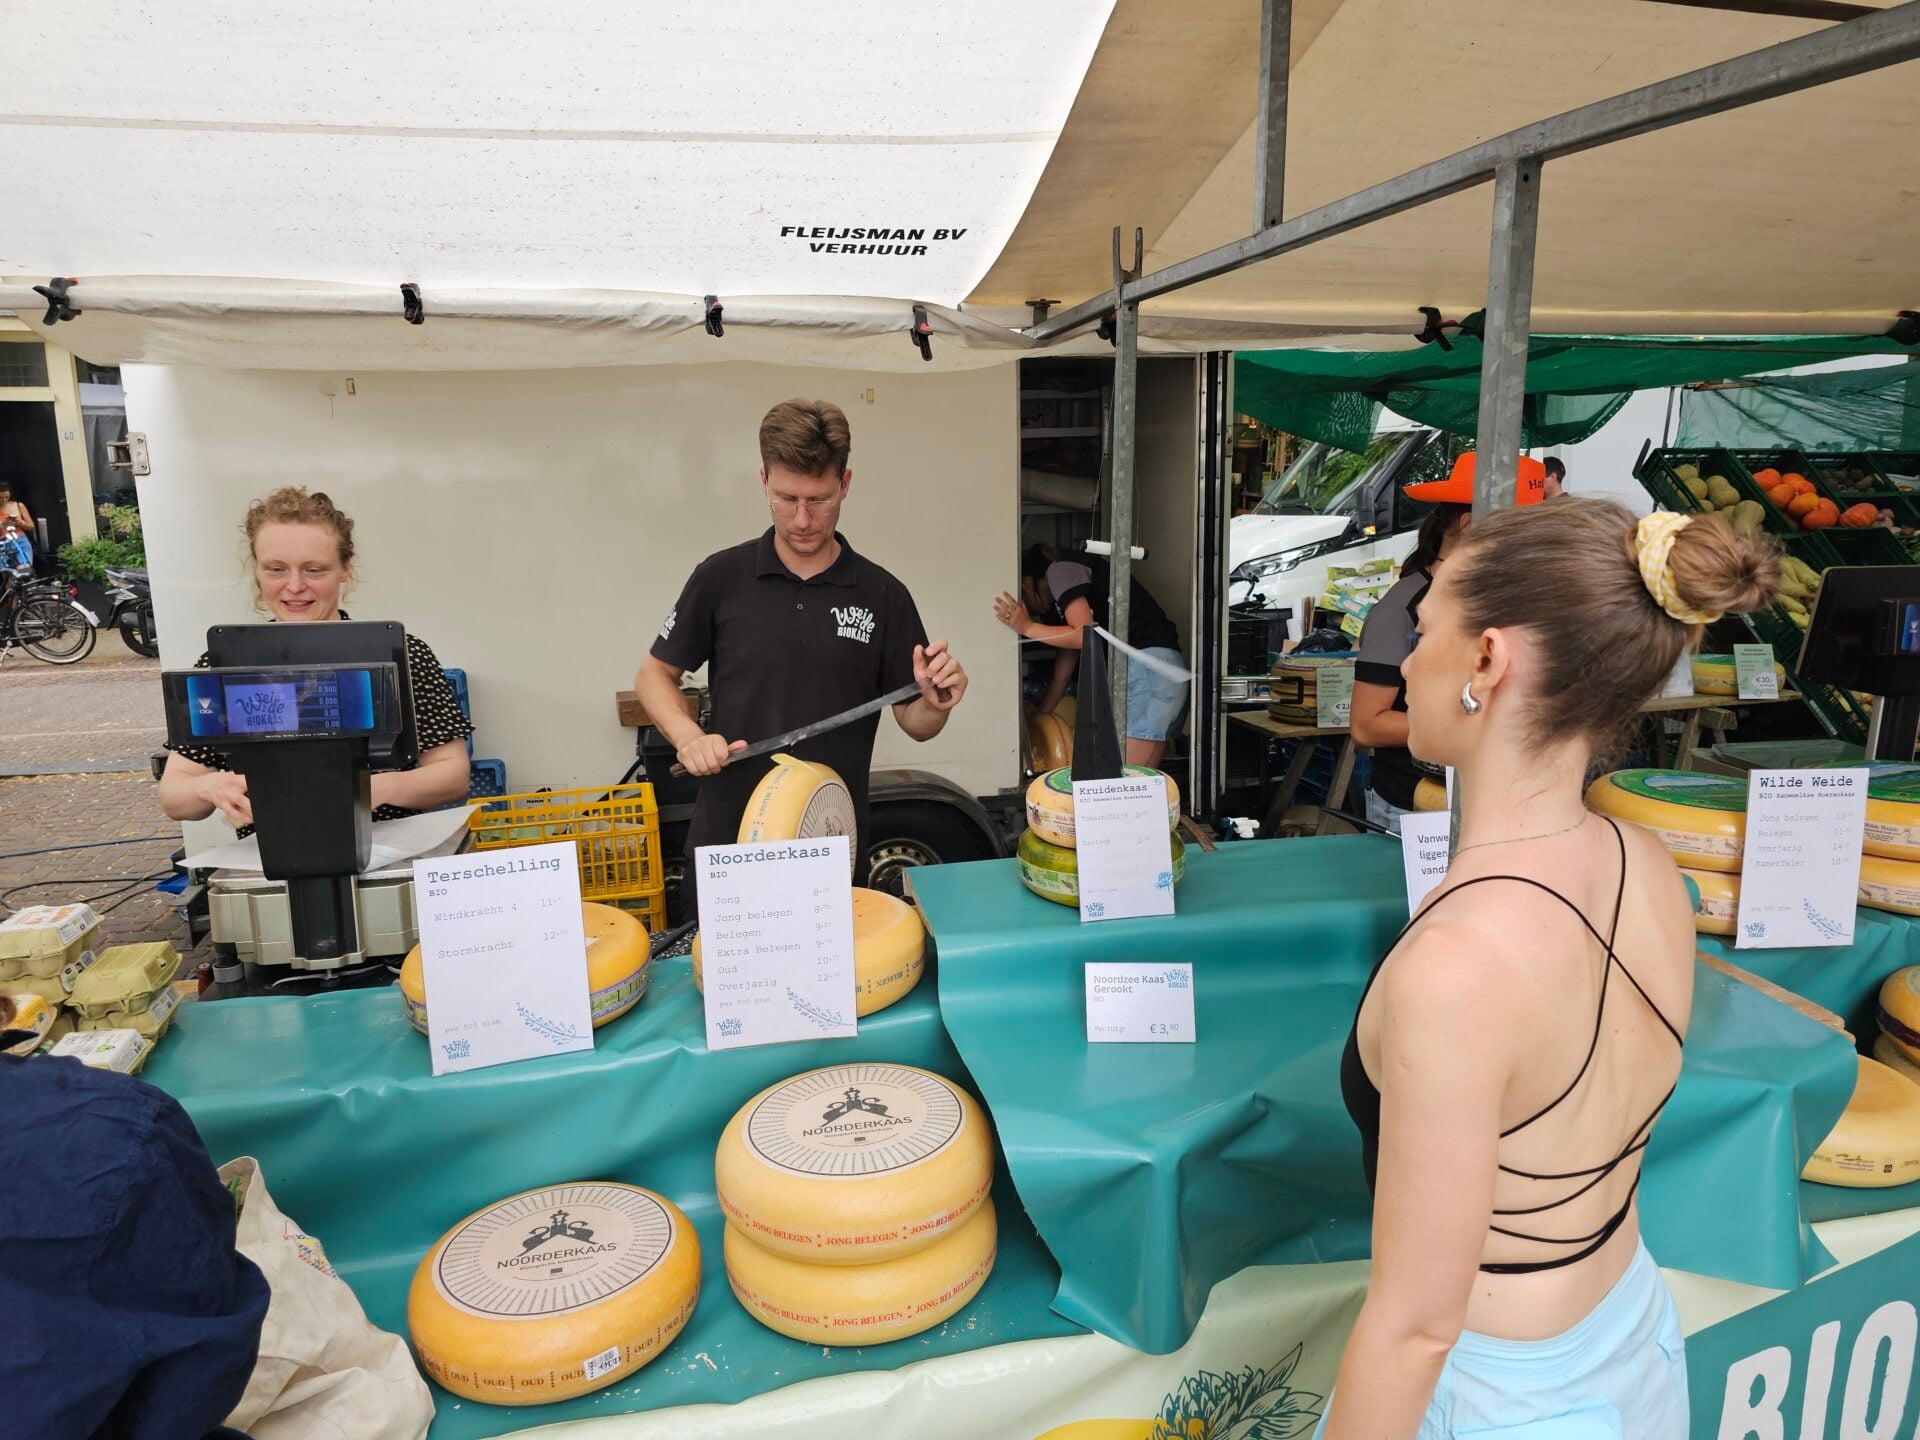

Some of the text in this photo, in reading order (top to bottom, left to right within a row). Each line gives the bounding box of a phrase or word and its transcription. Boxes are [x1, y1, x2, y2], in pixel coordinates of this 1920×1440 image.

[780, 226, 968, 240] FLEIJSMAN BV
[809, 243, 928, 256] VERHUUR
[837, 626, 871, 644] BIOKAAS
[247, 714, 284, 726] BIOKAAS
[1759, 775, 1853, 788] Wilde Weide
[1079, 784, 1148, 796] Kruidenkaas
[1759, 814, 1780, 823] Jong
[1784, 814, 1819, 823] belegen
[1758, 830, 1793, 838] Belegen
[1756, 844, 1802, 853] Overjarig
[709, 847, 831, 866] Noorderkaas
[428, 858, 561, 883] Terschelling
[710, 871, 728, 879] BIO
[429, 888, 448, 897] BIO
[714, 896, 740, 905] Jong
[434, 905, 504, 922] Windkracht
[511, 903, 518, 912] 4
[715, 913, 741, 923] Jong
[747, 908, 793, 920] belegen
[716, 929, 761, 940] Belegen
[438, 940, 514, 959] Stormkracht
[717, 948, 749, 957] Extra
[756, 943, 801, 954] Belegen
[718, 966, 738, 974] Oud
[718, 979, 777, 991] Overjarig
[1093, 975, 1165, 984] Noordzee Kaas
[1094, 985, 1133, 994] Gerookt
[1150, 1023, 1157, 1034] €
[802, 1116, 913, 1137] NOORDERKAAS
[753, 1220, 772, 1235] JONG
[773, 1229, 812, 1244] BELEGEN
[826, 1236, 852, 1246] JONG
[855, 1231, 898, 1245] BELEGEN
[911, 1221, 934, 1235] JONG
[497, 1242, 617, 1269] NOORDERKAAS
[761, 1301, 780, 1316] JONG
[781, 1309, 820, 1324] BELEGEN
[832, 1318, 858, 1327] JONG
[860, 1311, 904, 1325] BELEGEN
[916, 1298, 939, 1314] JONG
[450, 1371, 469, 1383] OUD
[483, 1378, 505, 1387] OUD
[521, 1378, 545, 1387] OUD
[561, 1369, 585, 1382] OUD
[600, 1356, 622, 1370] OUD
[634, 1338, 653, 1354] OUD
[1717, 1300, 1920, 1440] BIO
